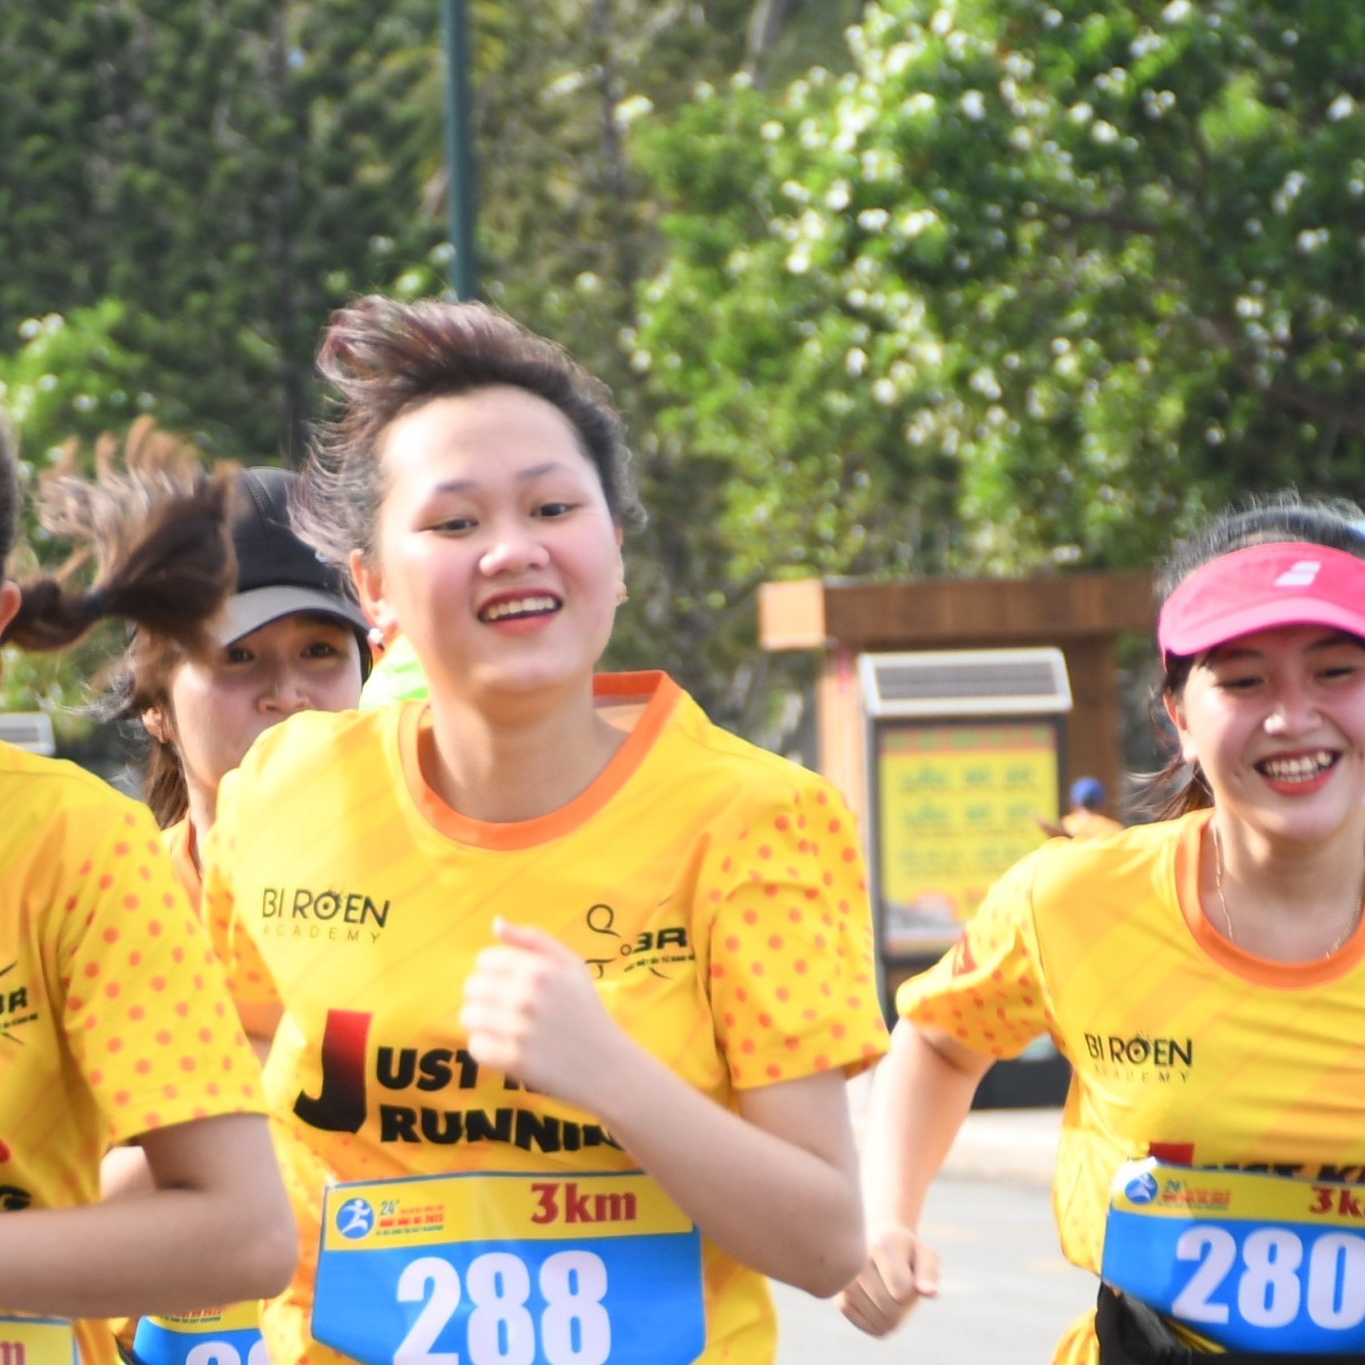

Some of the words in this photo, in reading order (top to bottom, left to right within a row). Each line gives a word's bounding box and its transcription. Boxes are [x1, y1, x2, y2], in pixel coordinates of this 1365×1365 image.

[262, 888, 285, 918] BI
[292, 889, 390, 928] ROEN
[263, 924, 381, 944] ACADEMY
[1084, 1033, 1104, 1061] BI
[1108, 1034, 1192, 1067] ROEN
[379, 1104, 624, 1154] RUNNIN
[530, 1182, 638, 1225] 3km
